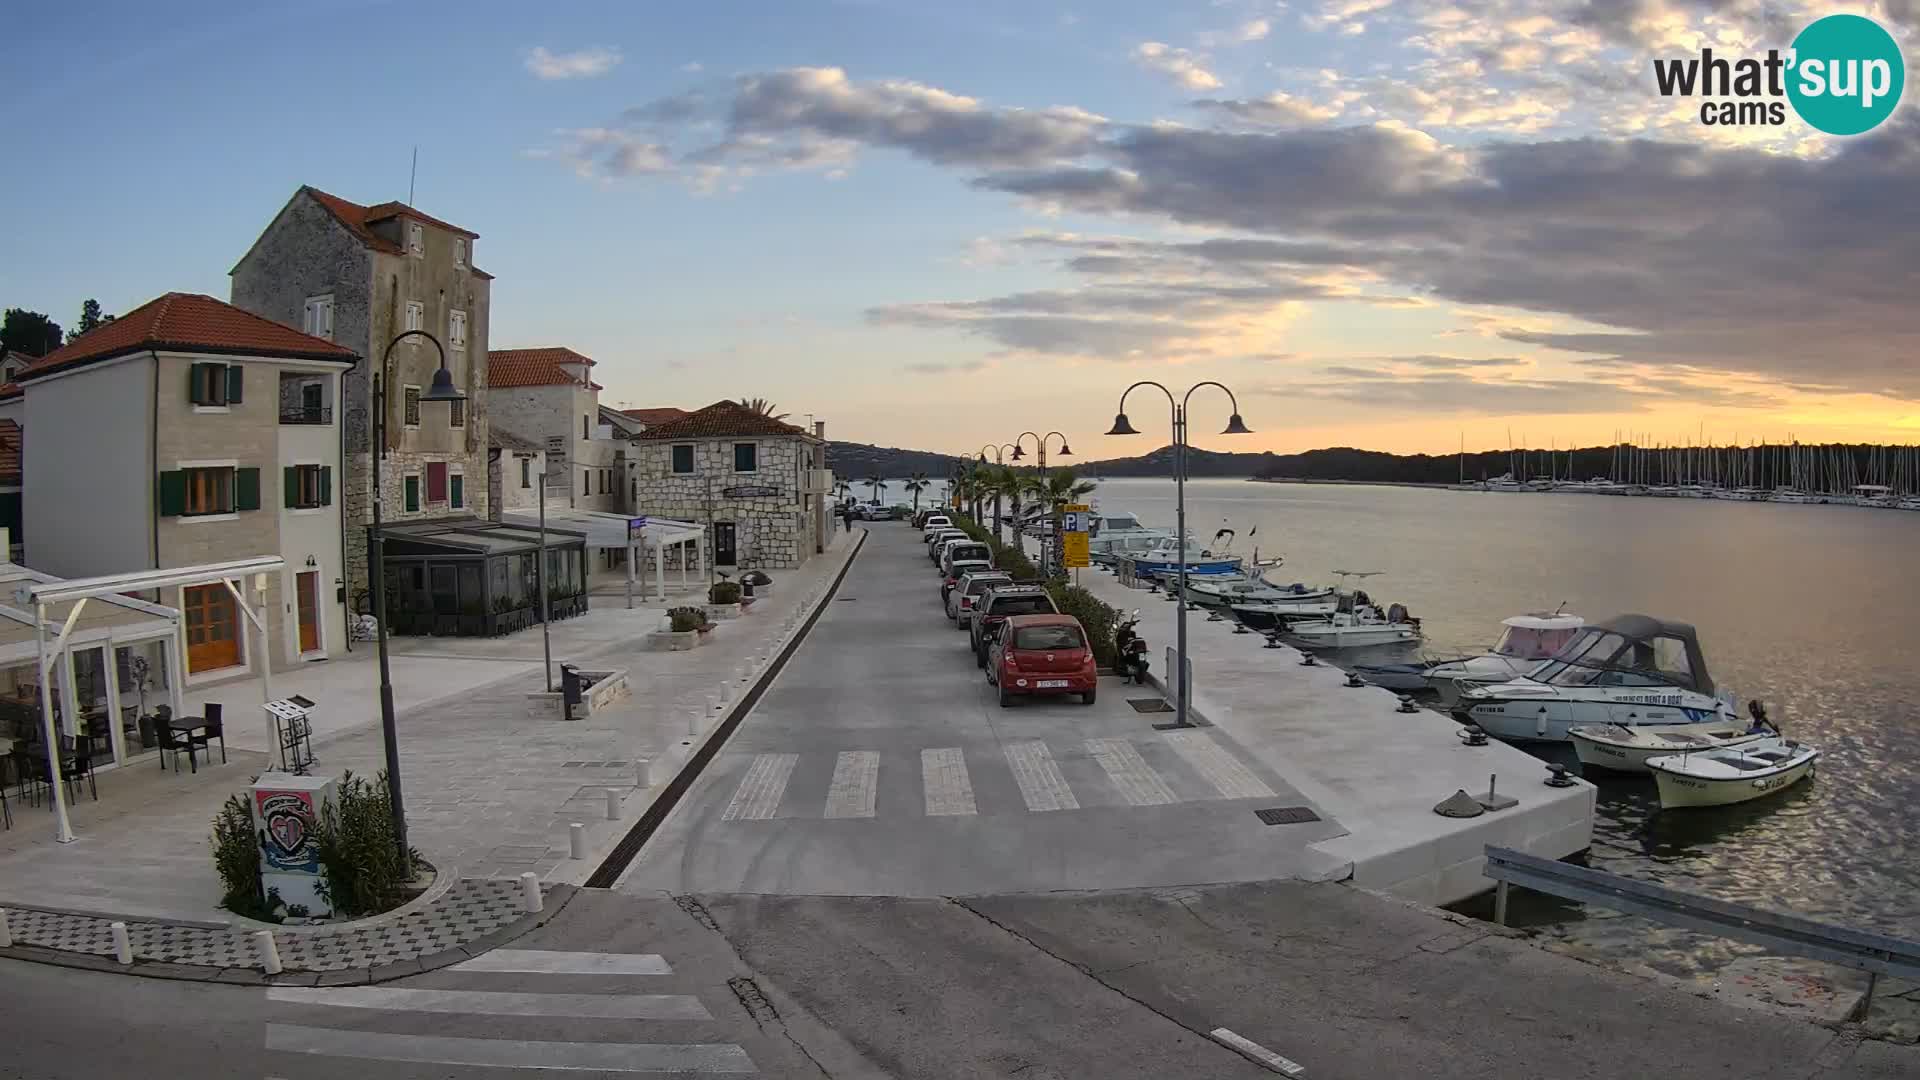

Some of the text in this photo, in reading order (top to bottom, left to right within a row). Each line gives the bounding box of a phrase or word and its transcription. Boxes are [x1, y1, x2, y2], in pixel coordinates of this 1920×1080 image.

[1066, 514, 1076, 530] P
[1644, 695, 1661, 704] RENT
[1661, 695, 1666, 704] A
[1667, 695, 1683, 705] BOAT
